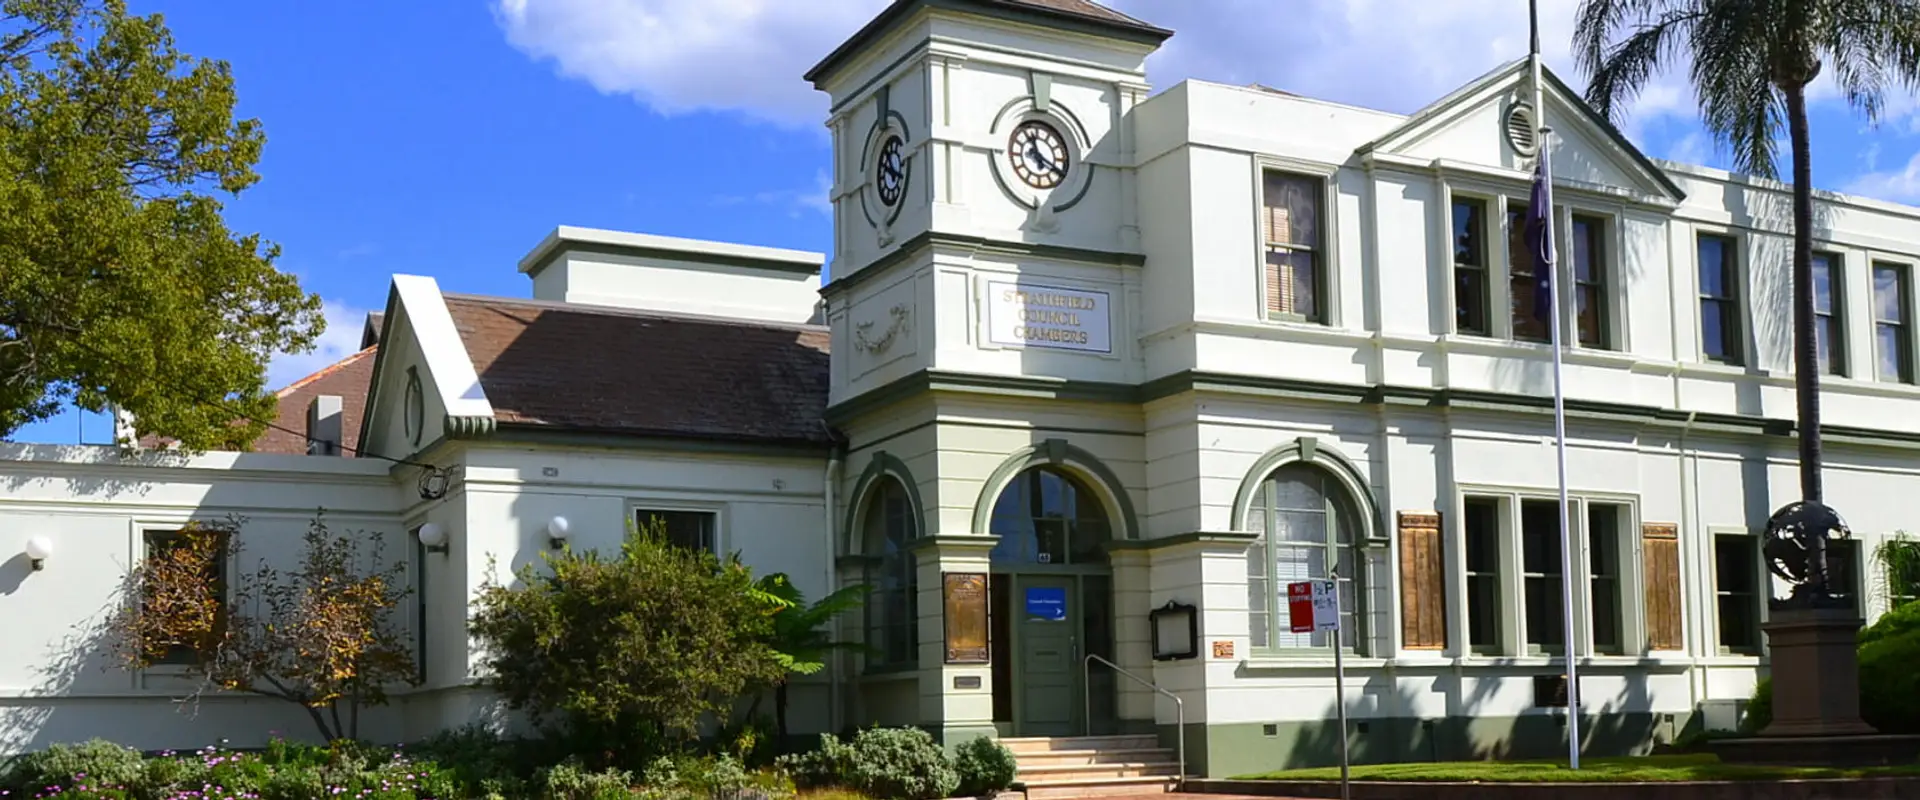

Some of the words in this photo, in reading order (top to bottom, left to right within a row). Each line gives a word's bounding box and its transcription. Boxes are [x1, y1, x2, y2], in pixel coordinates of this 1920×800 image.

[1003, 290, 1095, 311] STRATHFIELD
[1018, 308, 1080, 326] COUNCIL
[1013, 325, 1087, 344] CHAMBERS
[1294, 584, 1305, 594] NO
